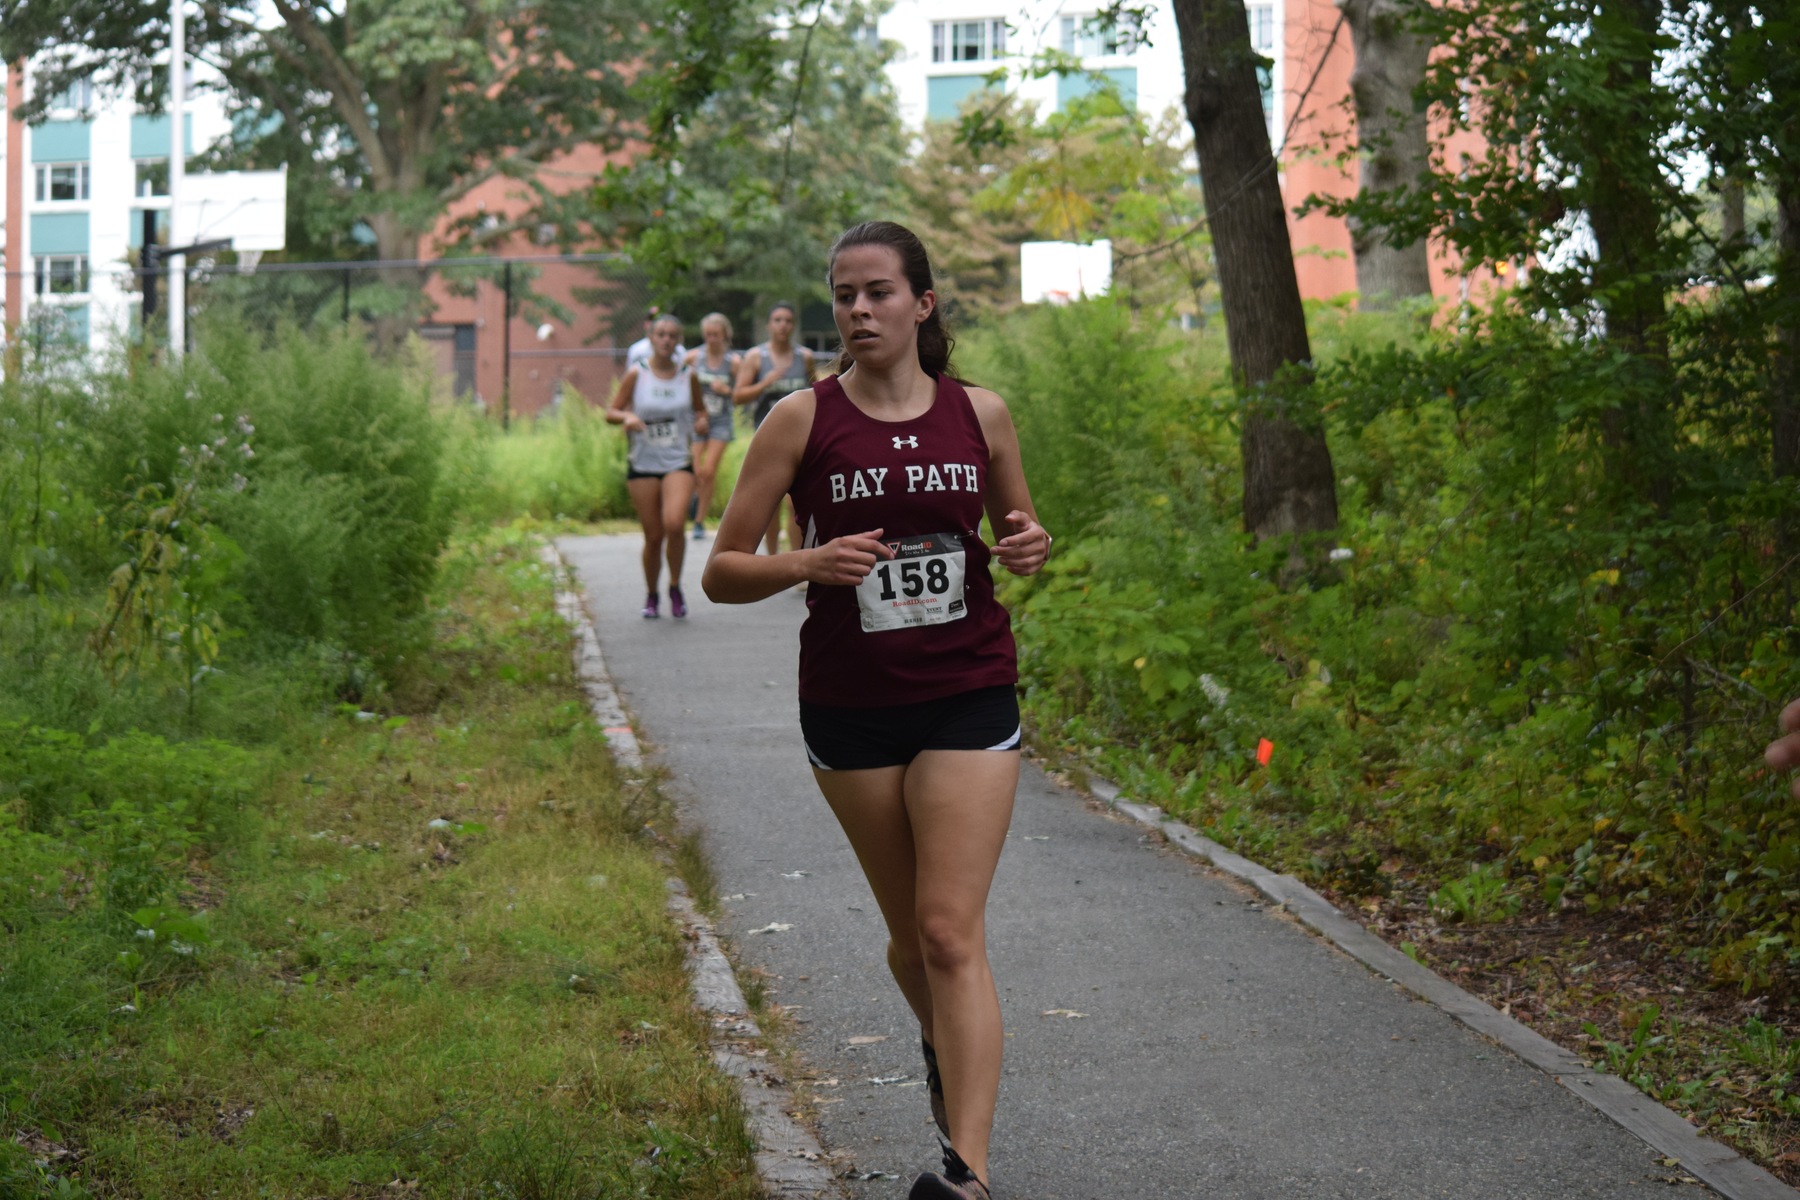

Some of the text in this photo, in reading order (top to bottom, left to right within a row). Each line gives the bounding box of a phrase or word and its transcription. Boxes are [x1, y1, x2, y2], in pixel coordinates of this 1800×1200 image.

[830, 463, 979, 503] BAY PATH
[877, 558, 949, 601] 158
[892, 597, 938, 608] RoadID.com
